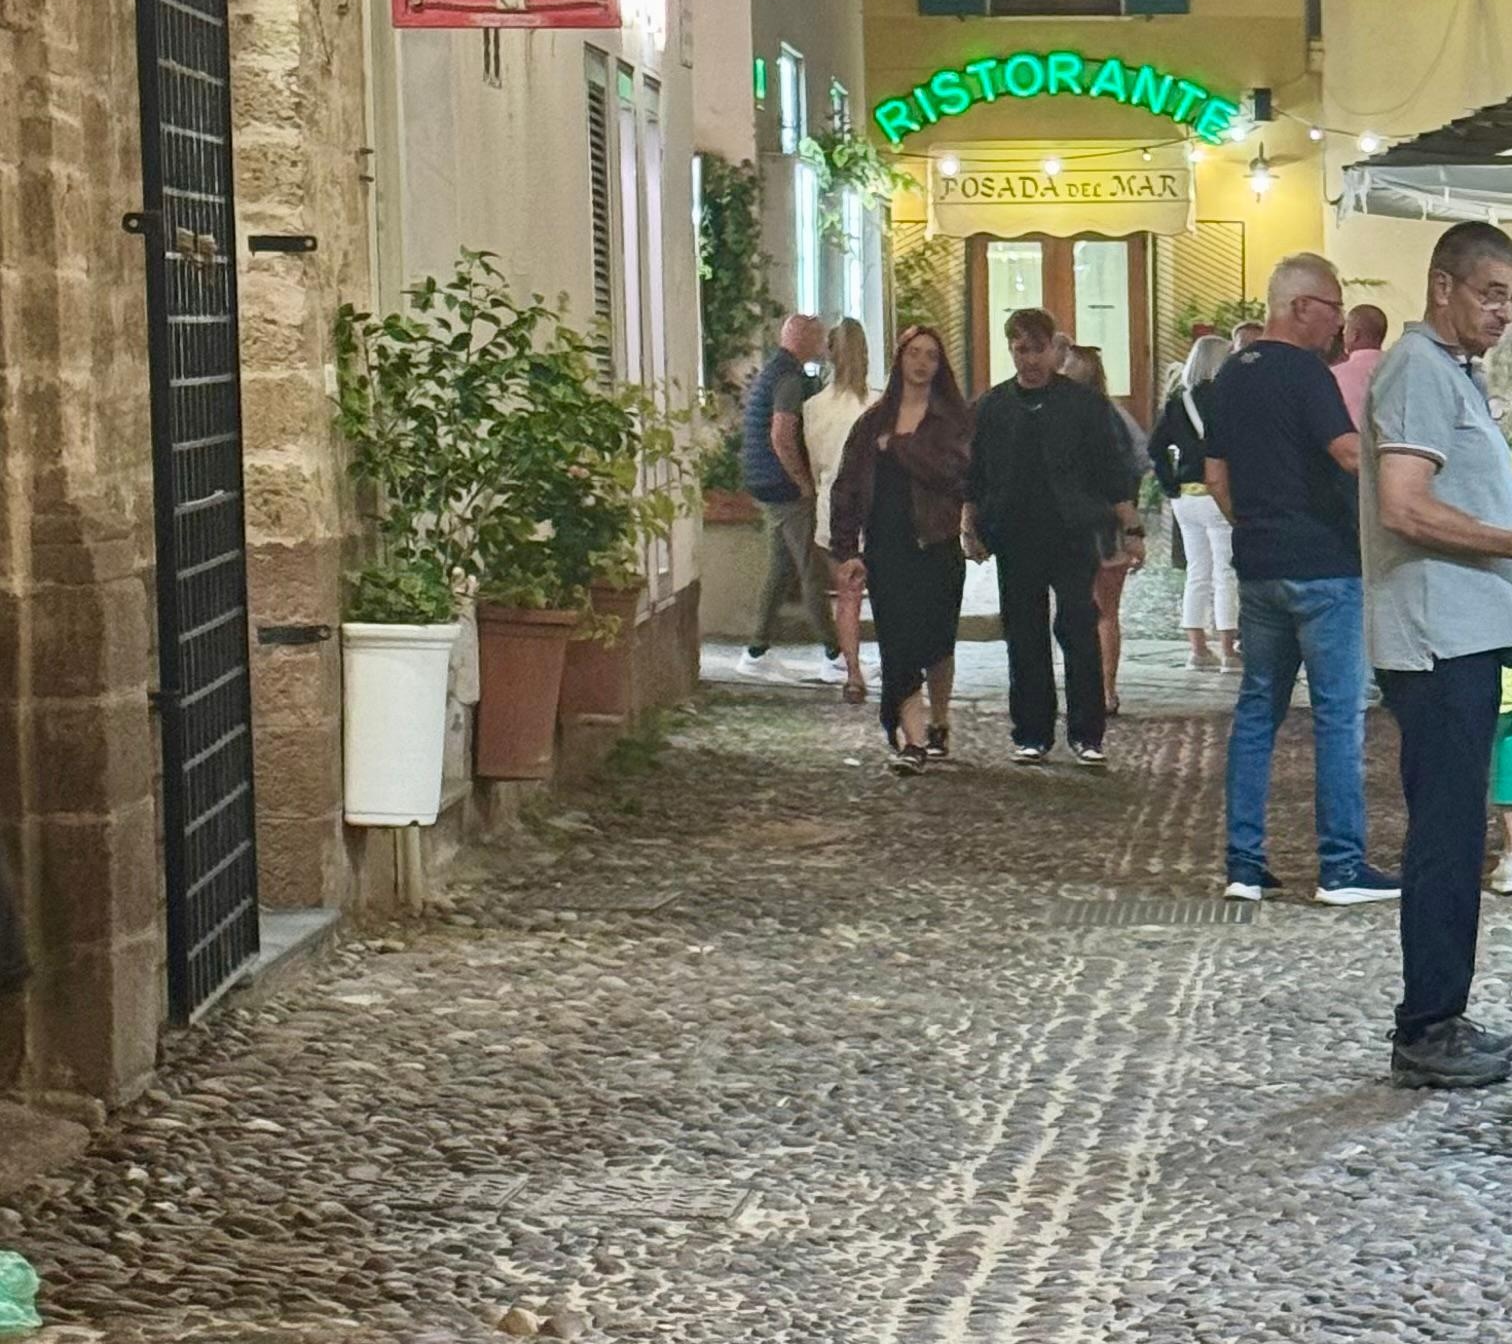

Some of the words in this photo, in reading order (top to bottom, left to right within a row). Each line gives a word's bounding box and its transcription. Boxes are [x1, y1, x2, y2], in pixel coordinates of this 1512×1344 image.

[875, 51, 1240, 145] RISTORANTE
[940, 174, 1060, 199] POSADA
[1066, 182, 1102, 198] DEL
[1109, 174, 1178, 197] MAR
